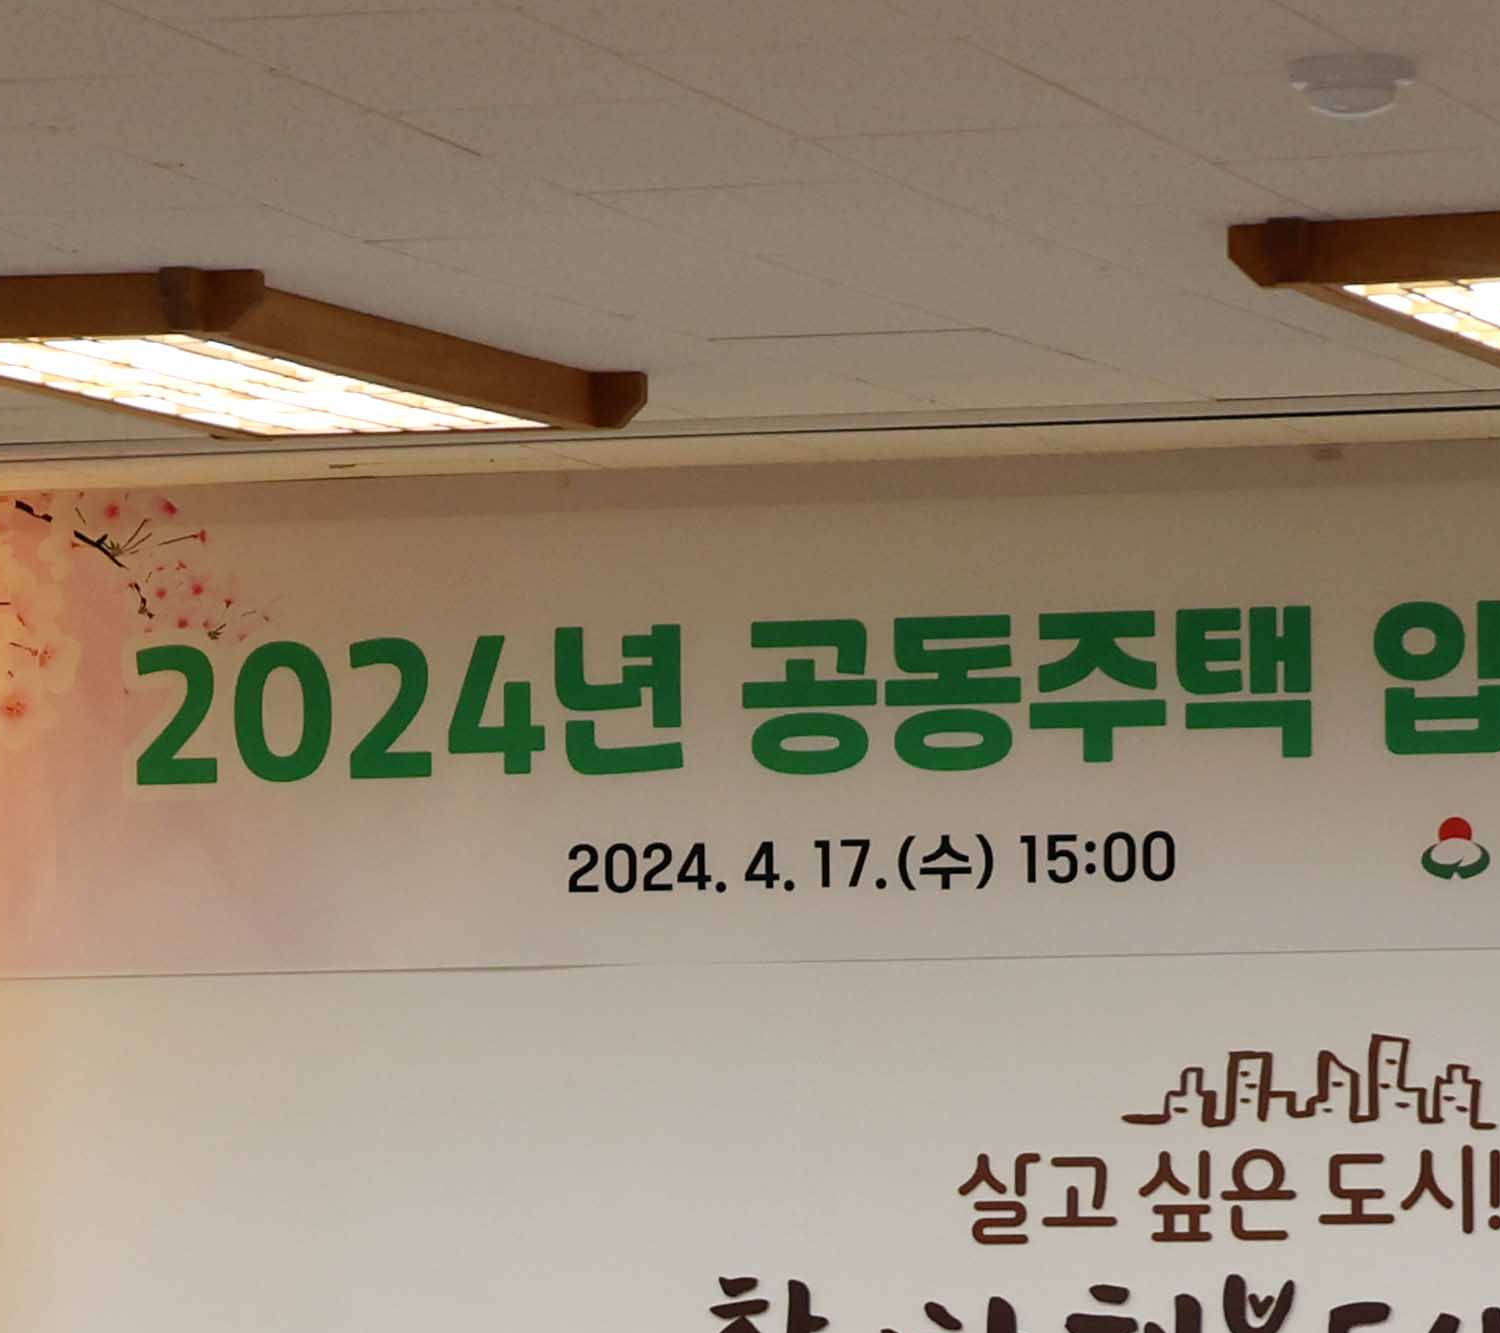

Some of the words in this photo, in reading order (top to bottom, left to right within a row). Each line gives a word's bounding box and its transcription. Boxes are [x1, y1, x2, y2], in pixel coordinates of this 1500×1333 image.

[136, 623, 686, 786] 2024년
[742, 605, 1314, 777] 공동주택
[1018, 829, 1177, 885] 15:00
[957, 1151, 1119, 1246] 살고
[1137, 1147, 1298, 1244] 싶은
